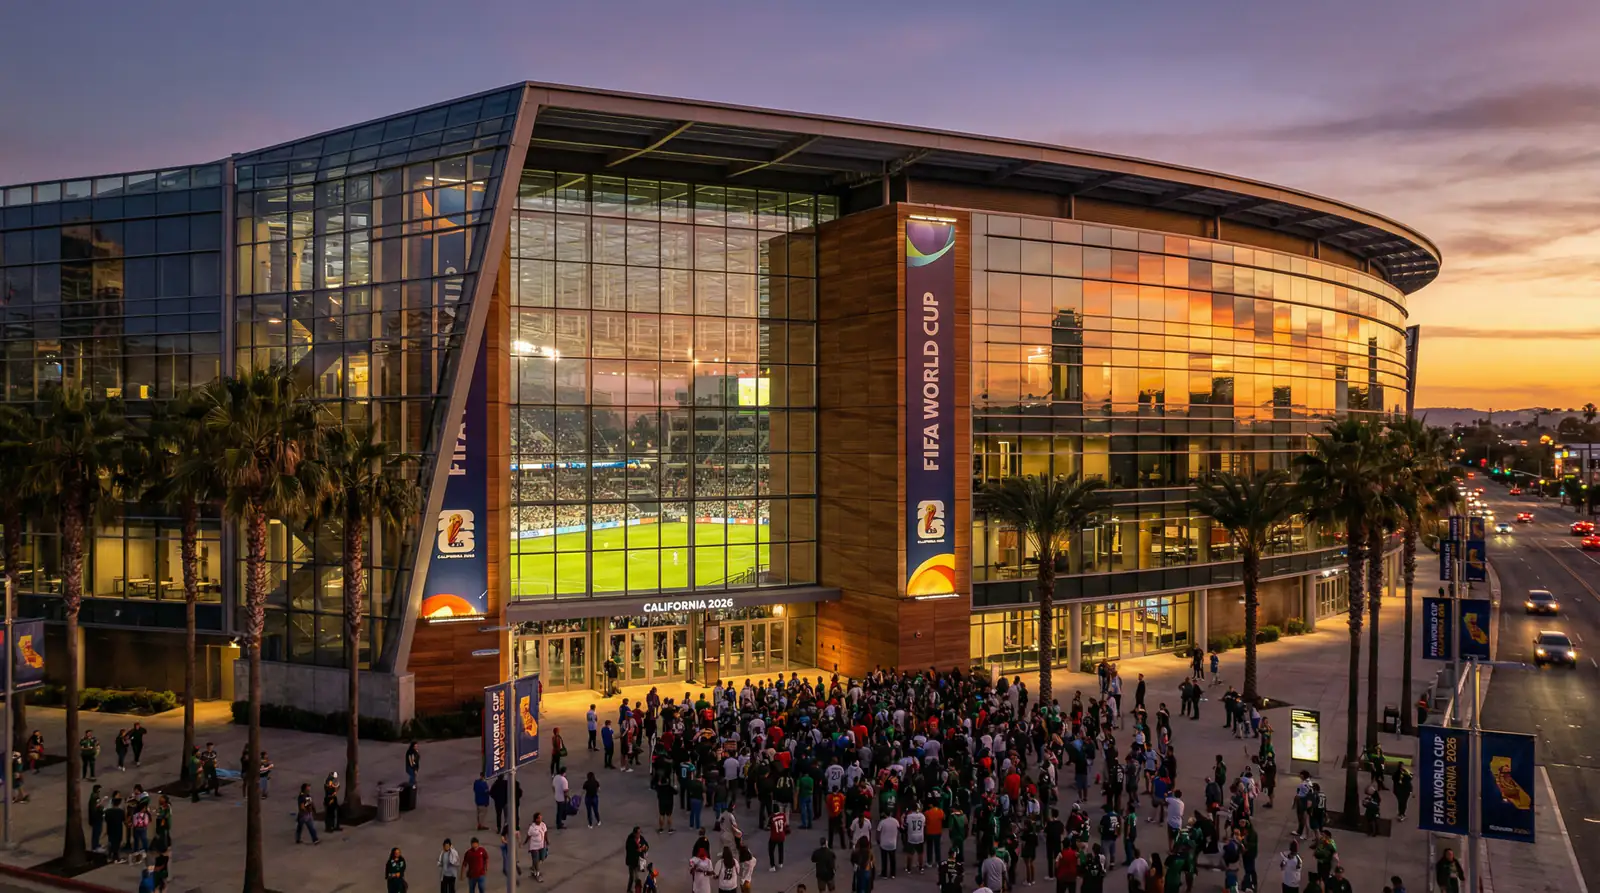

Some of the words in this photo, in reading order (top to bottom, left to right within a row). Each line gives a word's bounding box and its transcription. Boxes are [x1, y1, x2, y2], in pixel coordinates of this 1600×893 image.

[923, 292, 940, 336] CUP
[923, 341, 940, 420] WORLD
[923, 424, 940, 471] FIFA
[643, 600, 707, 613] CALIFORNIA
[708, 598, 734, 609] 2026
[1433, 736, 1445, 757] CUP
[1447, 737, 1457, 762] 2026
[1433, 760, 1445, 798] WORLD
[1447, 765, 1457, 826] CALIFORNIA
[1433, 801, 1445, 825] FIFA
